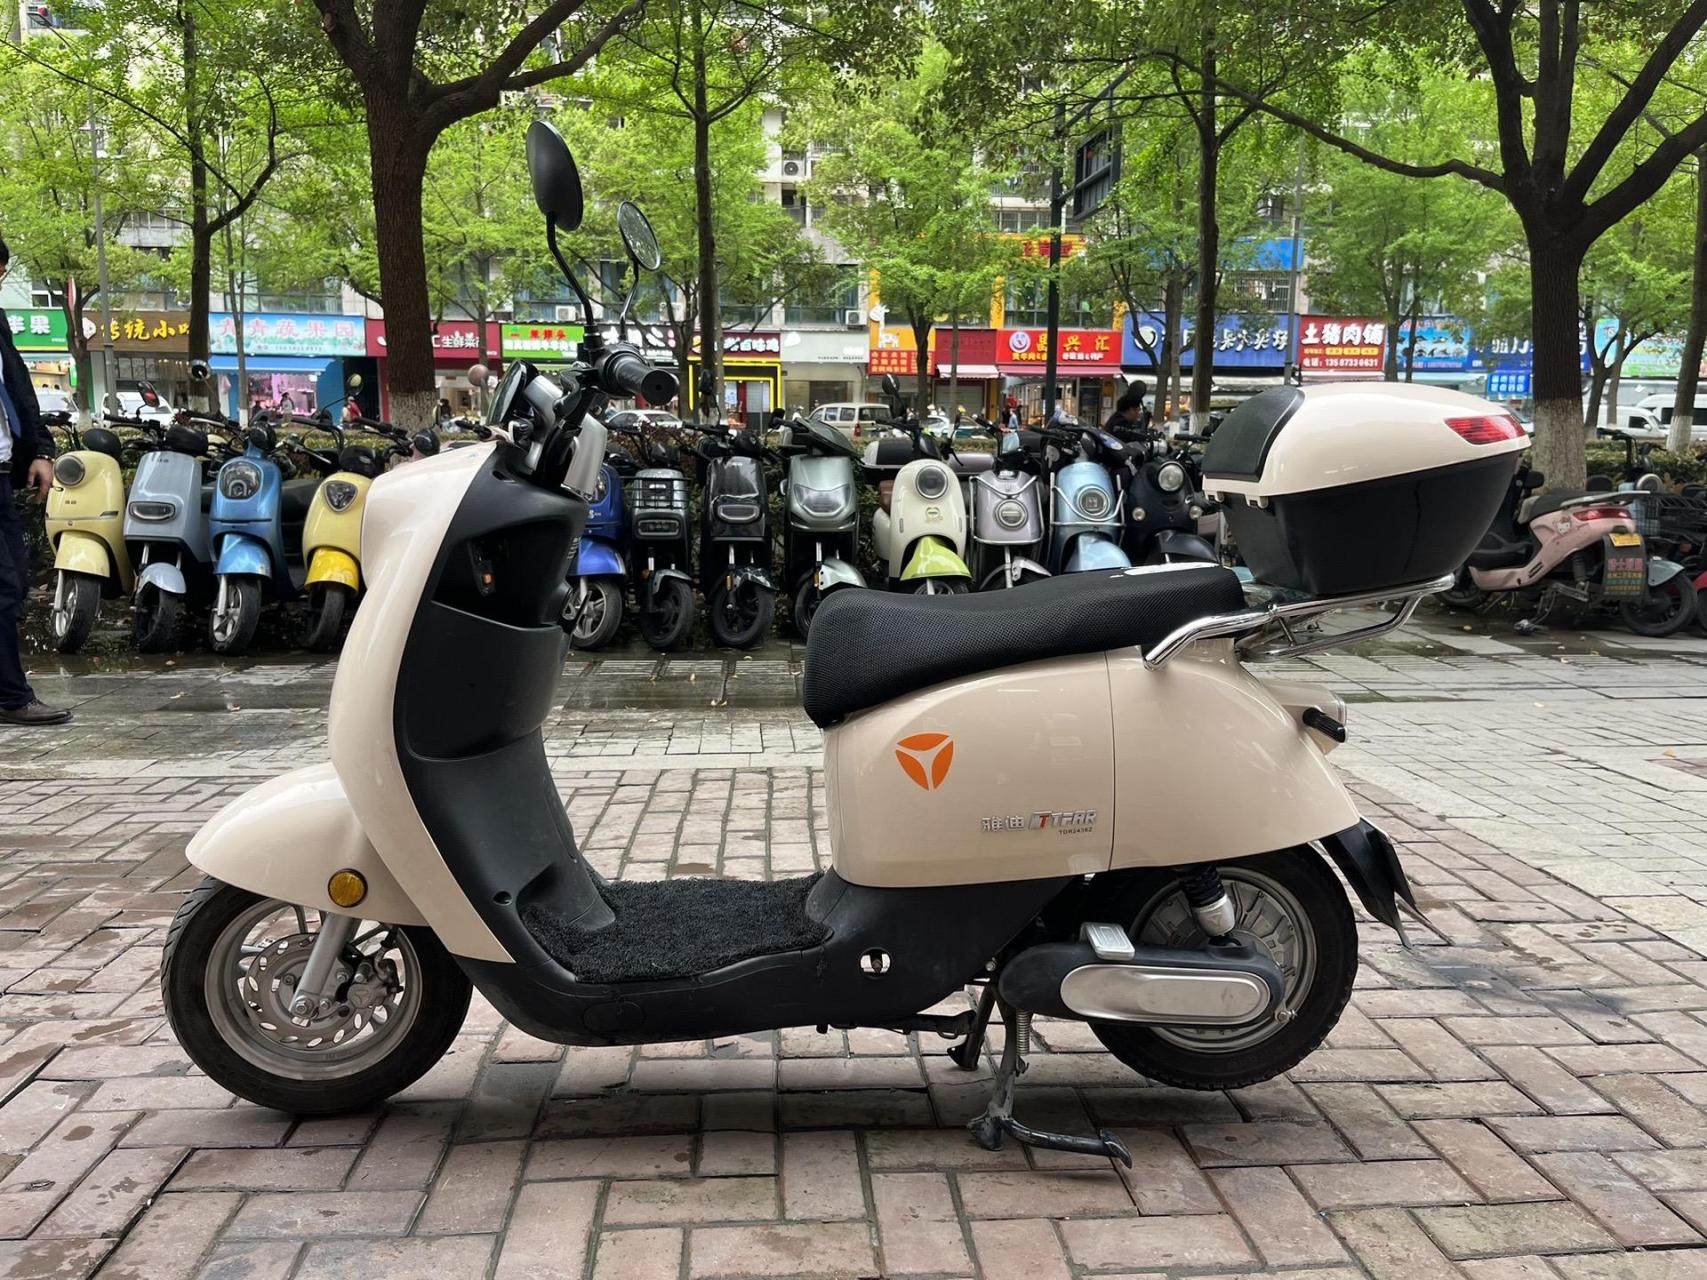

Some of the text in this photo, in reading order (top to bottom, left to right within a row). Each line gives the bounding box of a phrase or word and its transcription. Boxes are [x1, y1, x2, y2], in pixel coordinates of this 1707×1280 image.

[1301, 322, 1386, 346] 土猪肉铺
[981, 815, 1025, 832] 雅迪
